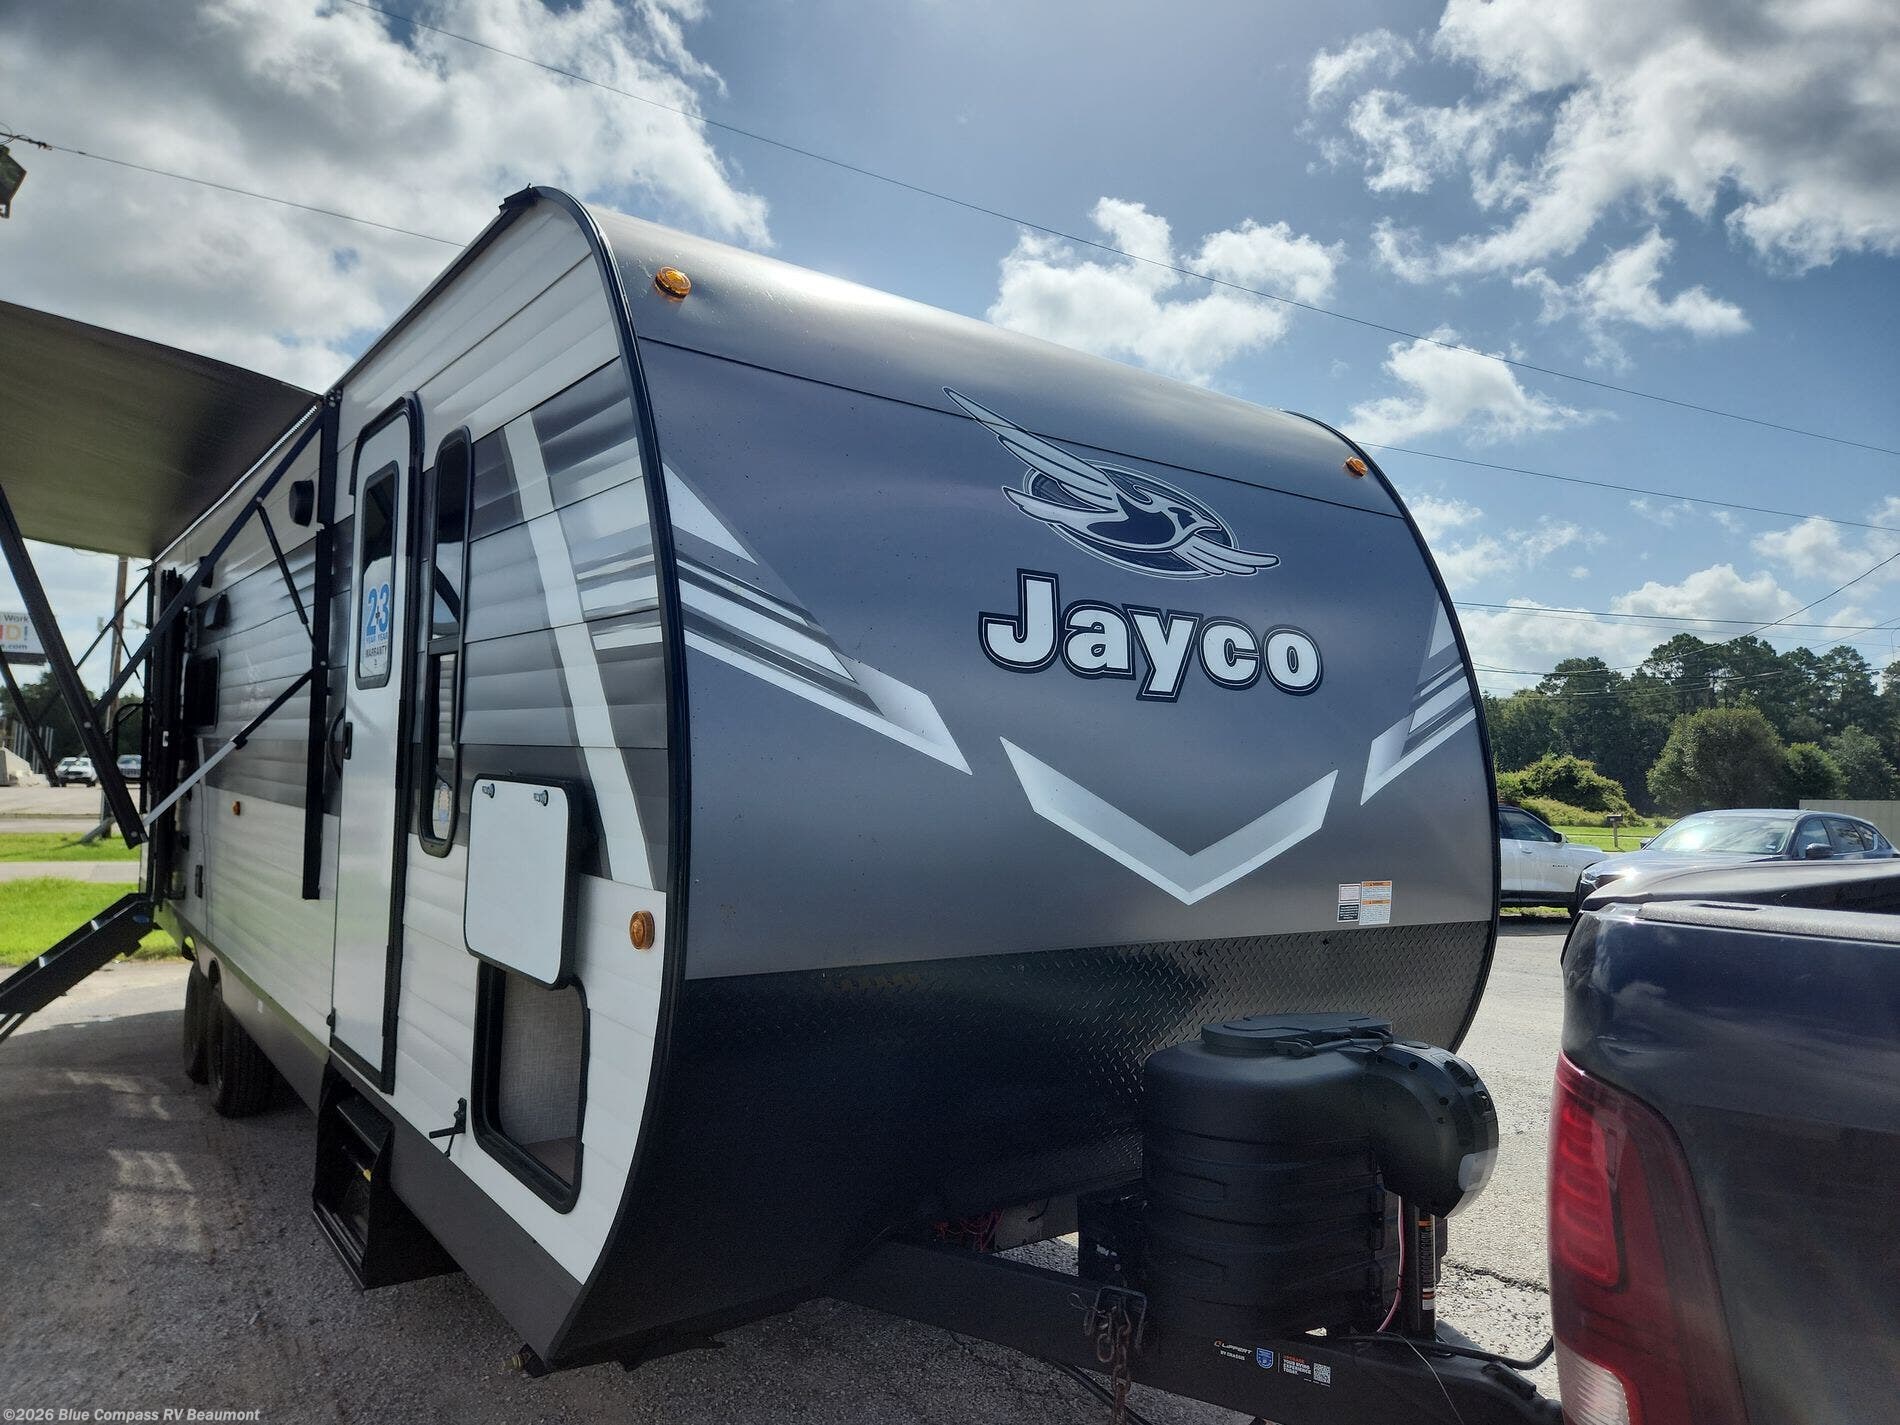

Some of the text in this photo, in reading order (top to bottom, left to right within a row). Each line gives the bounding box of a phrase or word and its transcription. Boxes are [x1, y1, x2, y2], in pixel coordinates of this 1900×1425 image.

[4, 614, 28, 622] Work
[978, 568, 1324, 703] Jayco
[366, 645, 387, 657] WARRANTY
